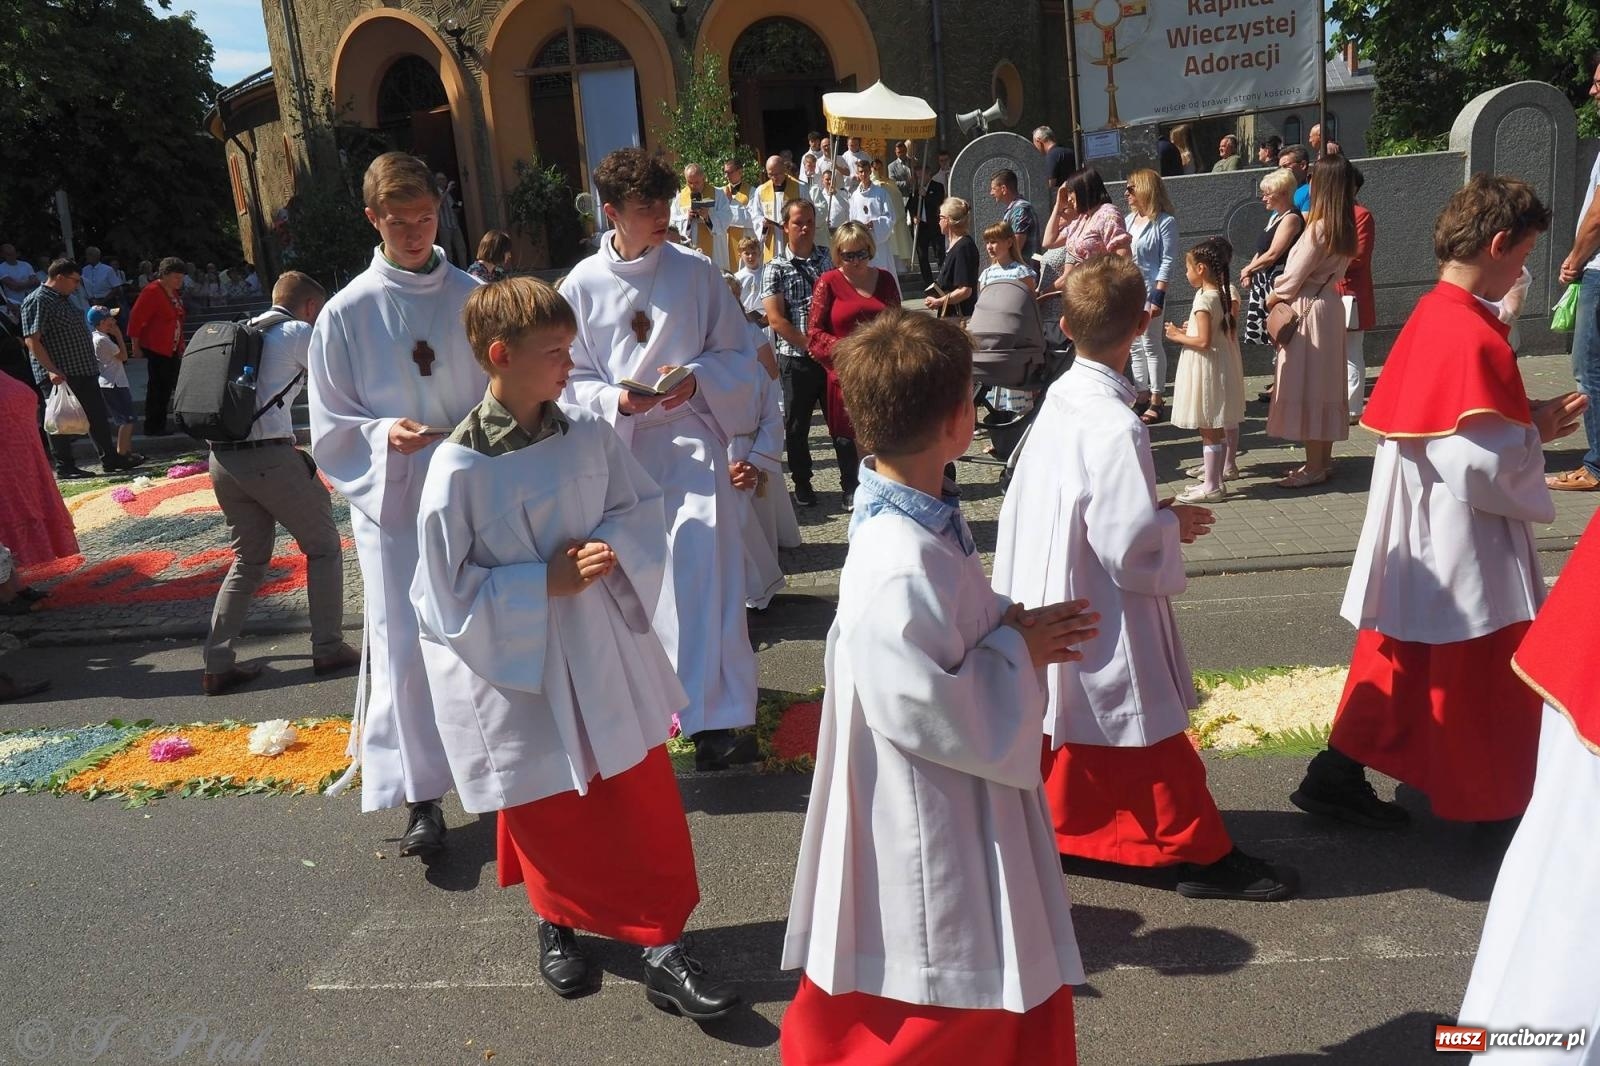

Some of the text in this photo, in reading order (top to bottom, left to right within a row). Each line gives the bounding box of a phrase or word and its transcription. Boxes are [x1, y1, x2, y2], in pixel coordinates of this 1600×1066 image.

[1166, 10, 1297, 48] Wieczystej
[1184, 43, 1280, 77] Adoracji
[1153, 103, 1186, 114] wejście
[1188, 100, 1200, 109] od
[1202, 95, 1231, 108] prawej
[1233, 91, 1262, 102] strony
